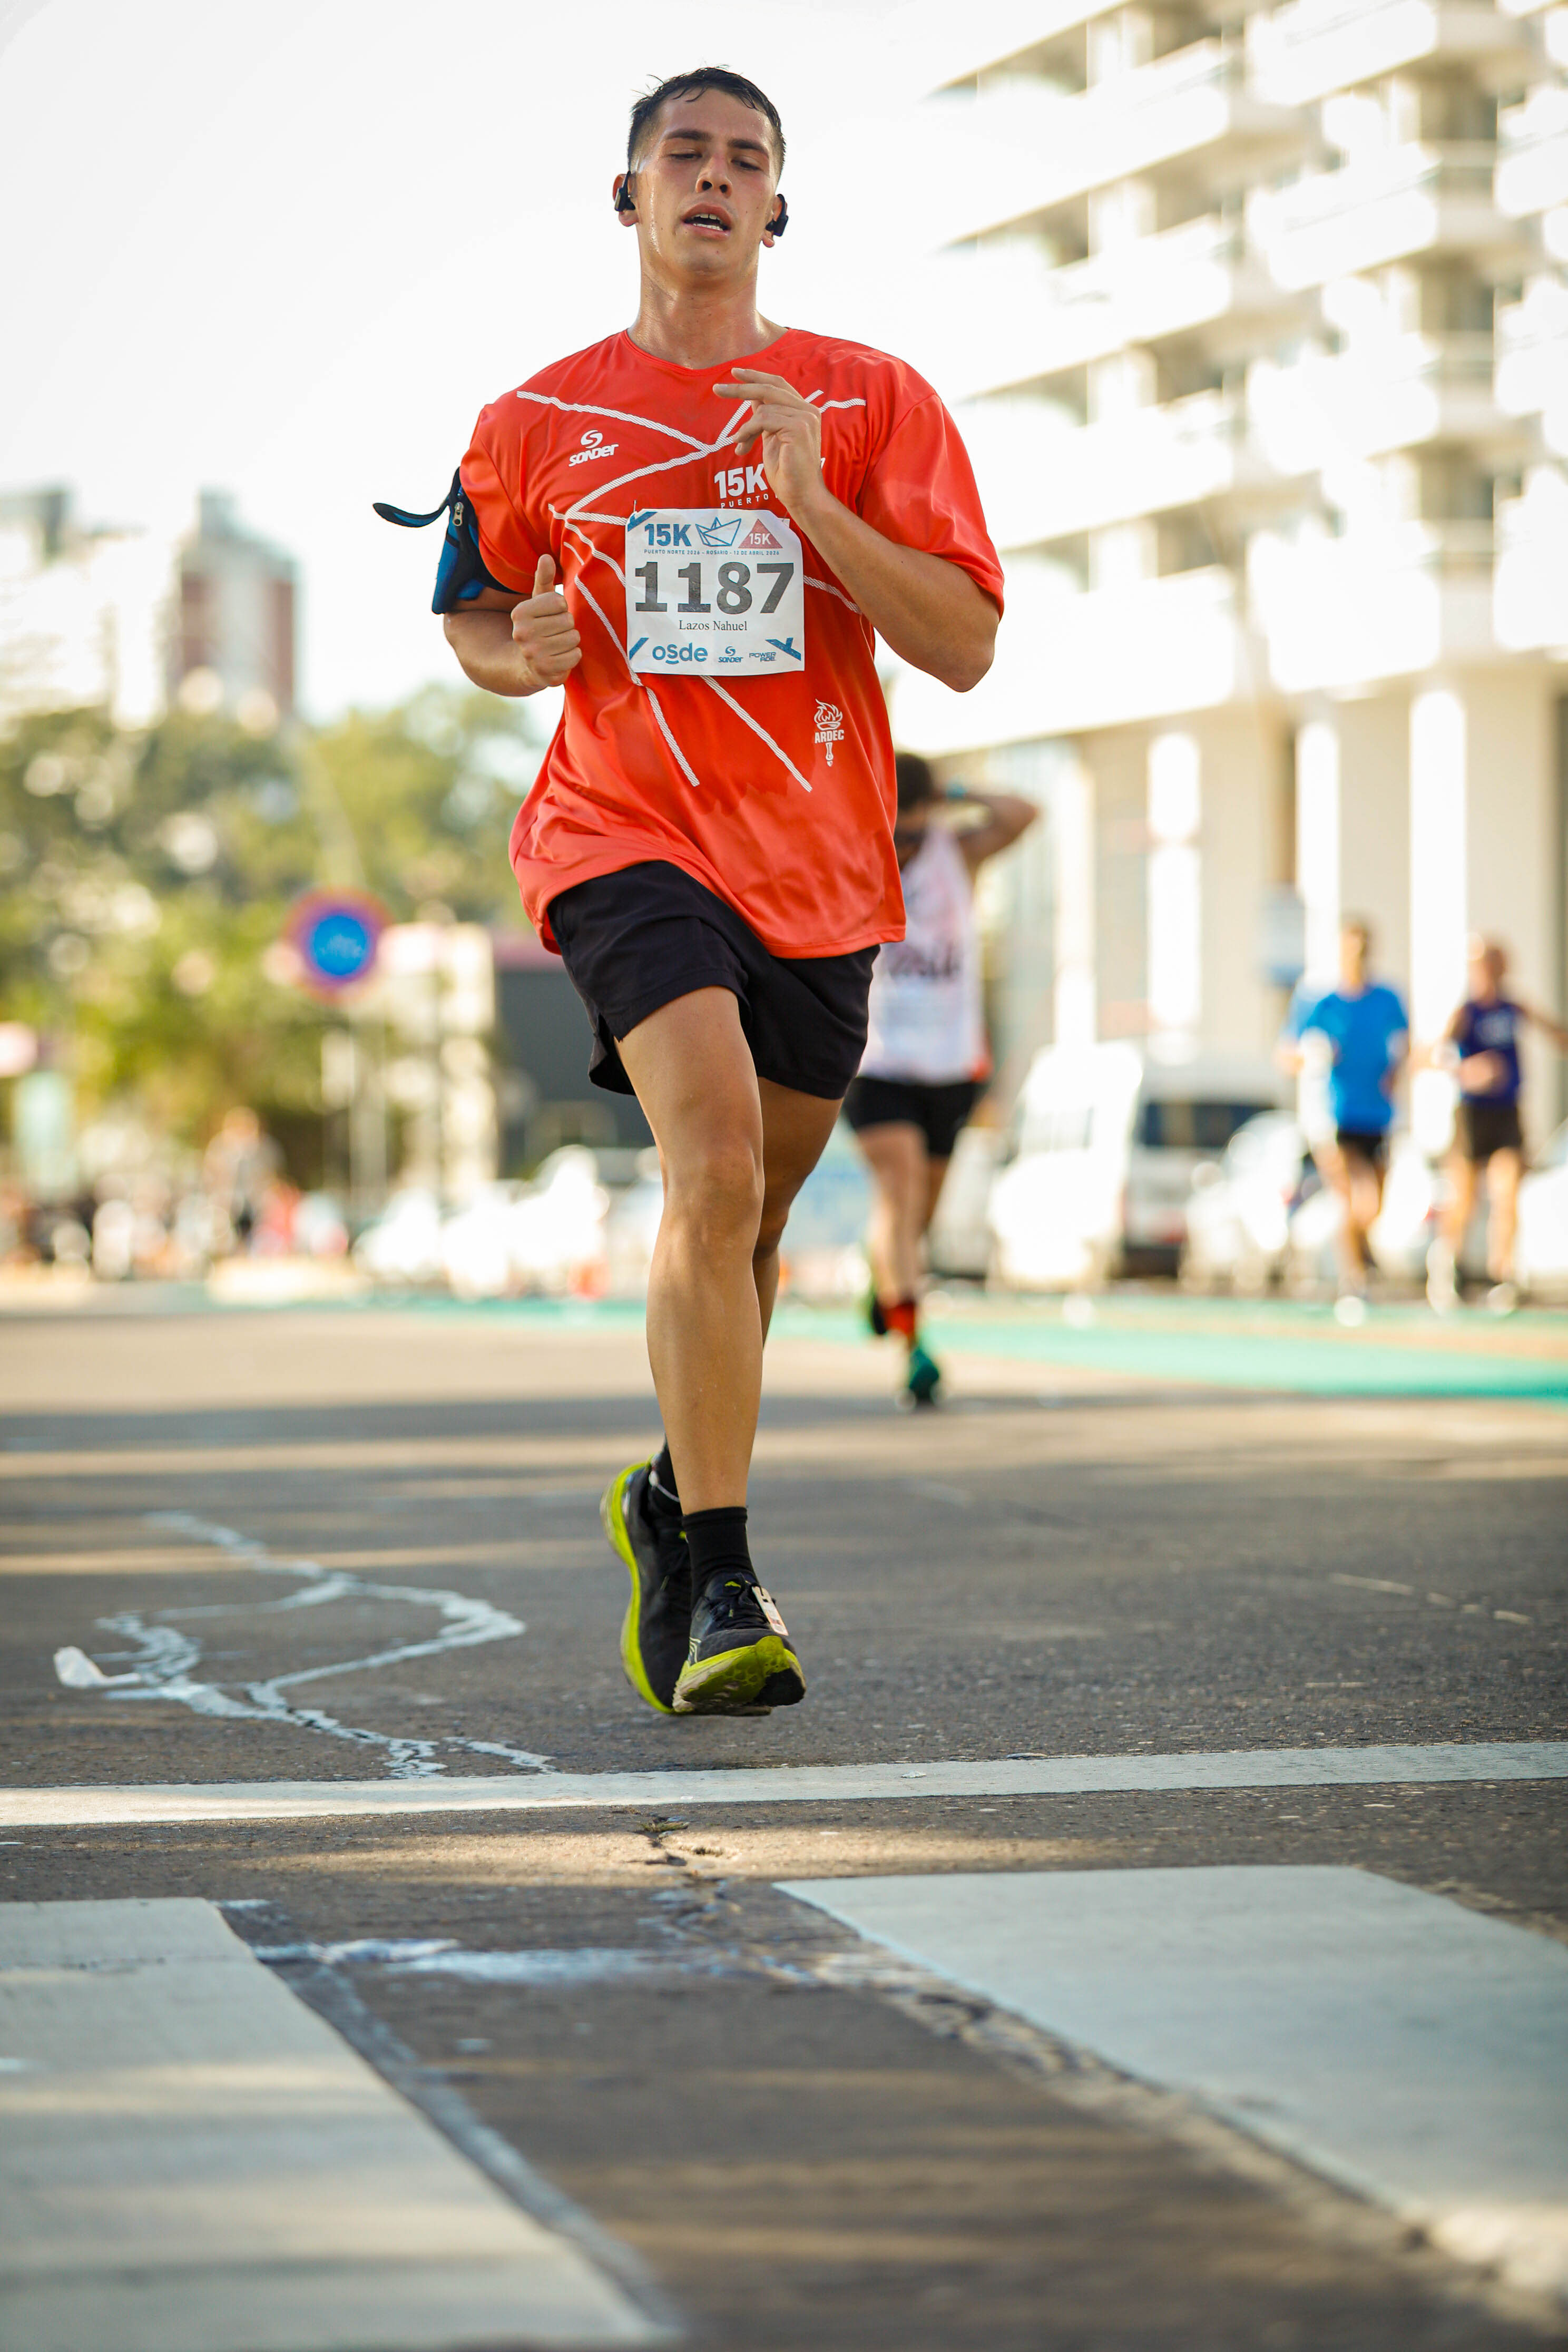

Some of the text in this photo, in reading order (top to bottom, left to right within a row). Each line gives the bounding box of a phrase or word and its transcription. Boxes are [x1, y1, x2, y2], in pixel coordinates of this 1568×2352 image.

[714, 463, 768, 499] 15K
[720, 493, 769, 508] PUERTO
[644, 524, 692, 546] 15K
[749, 533, 771, 545] 15K
[635, 561, 794, 614] 1187
[679, 620, 748, 631] Lazos Nahuel
[652, 642, 708, 662] osde
[814, 729, 845, 744] ARDEC
